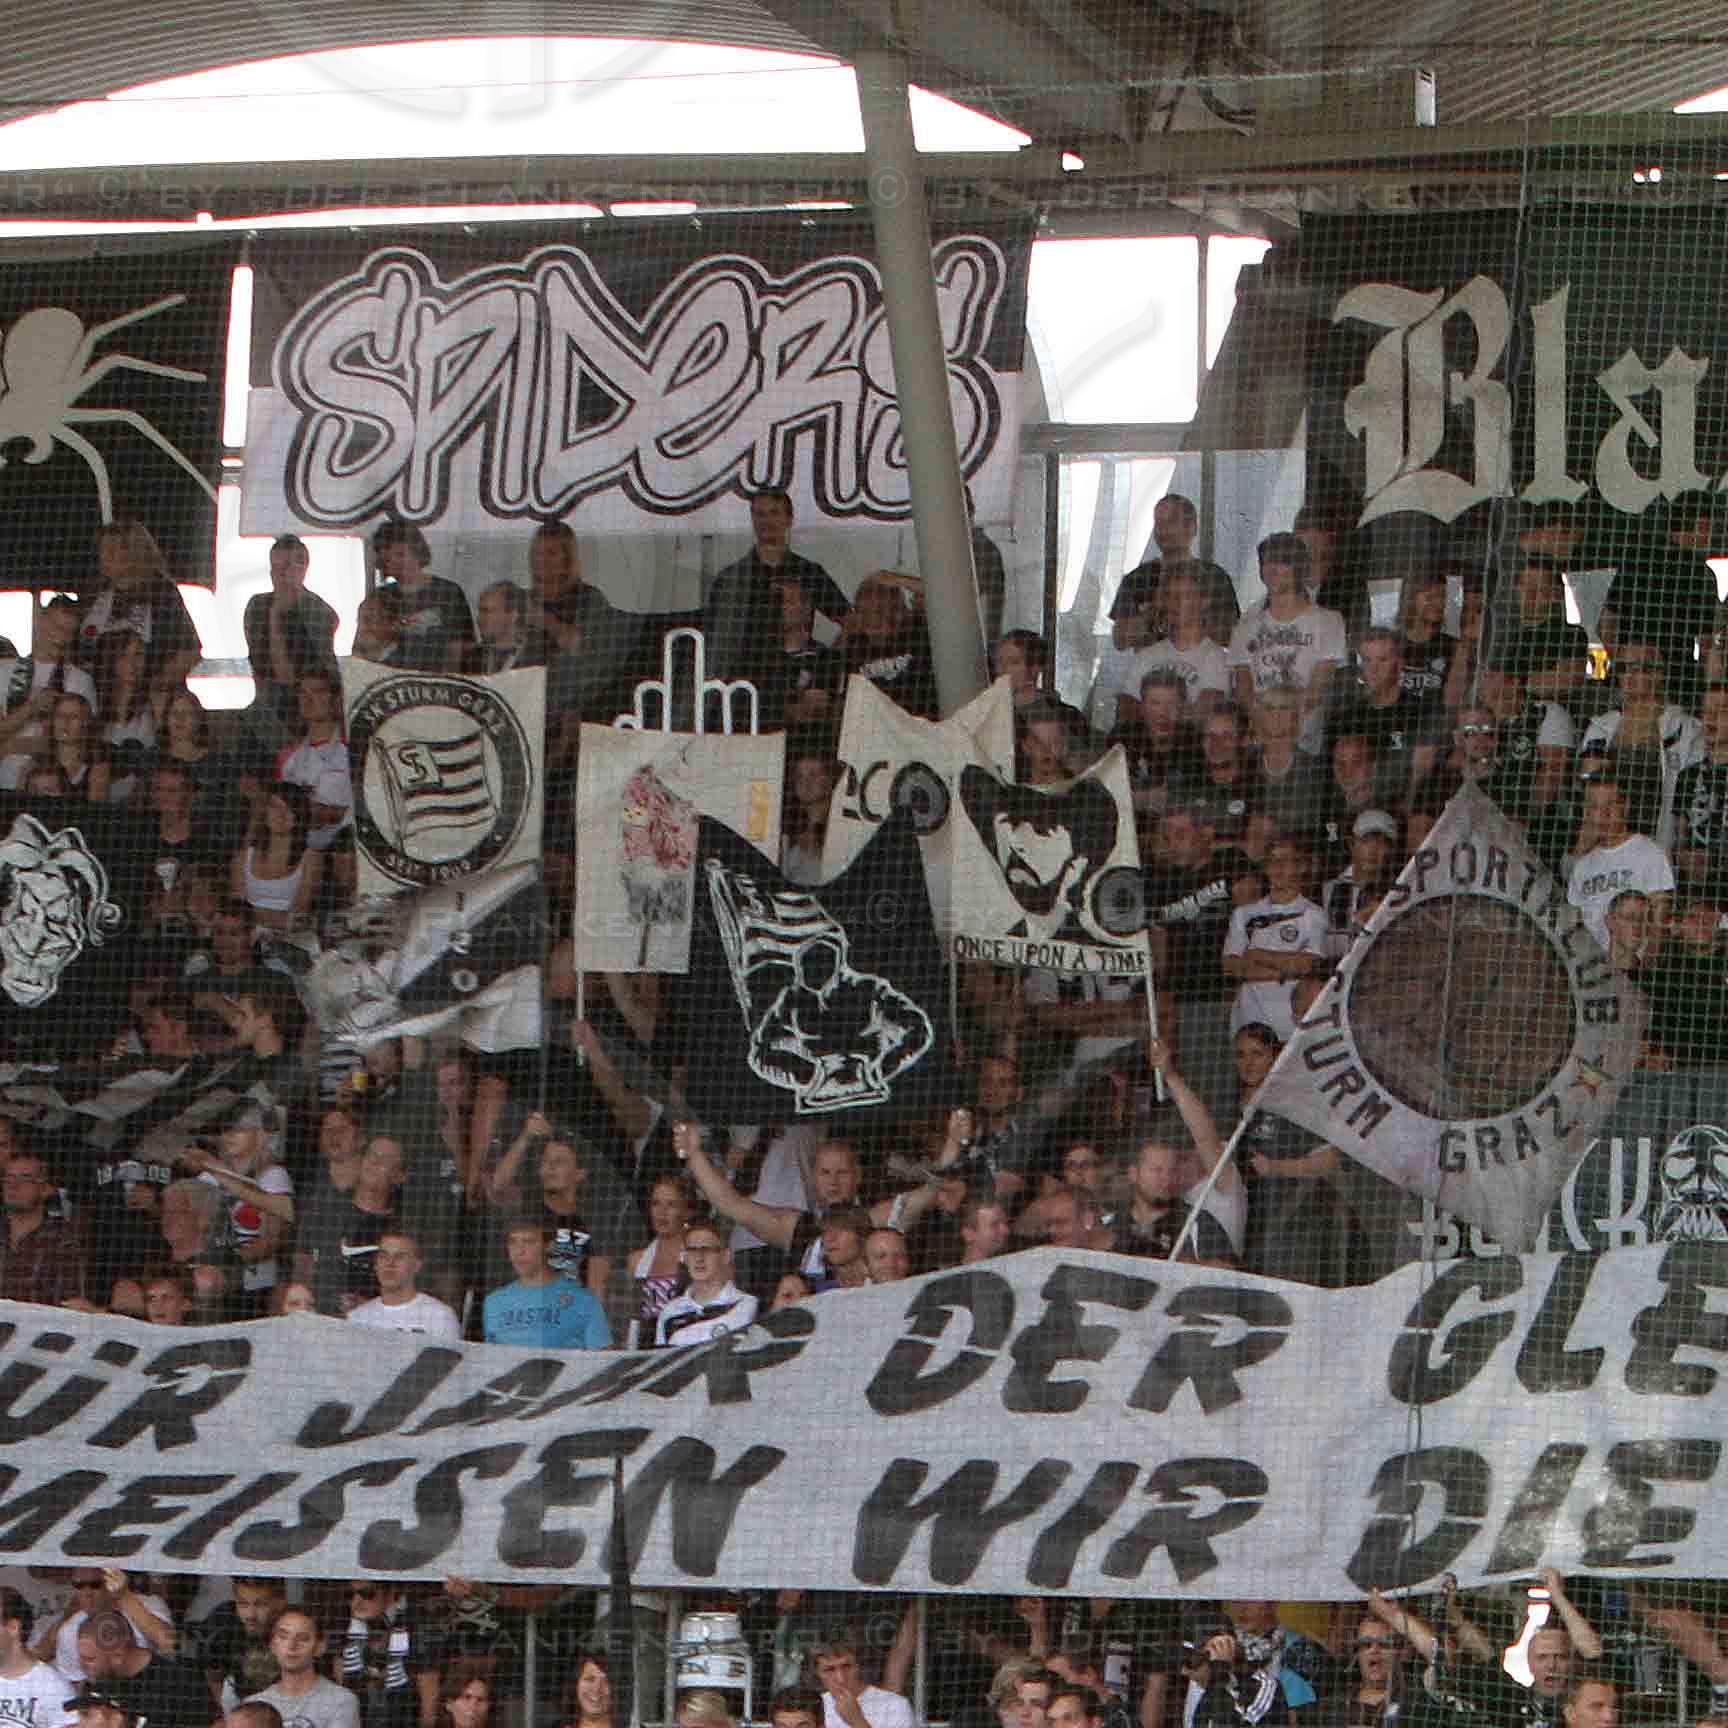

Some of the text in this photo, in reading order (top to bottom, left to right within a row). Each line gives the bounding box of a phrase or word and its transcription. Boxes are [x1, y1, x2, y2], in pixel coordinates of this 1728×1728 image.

[386, 685, 451, 712] STURM
[1580, 869, 1634, 897] GRAZ
[953, 935, 1148, 973] ONCE UPON A TIME
[1299, 966, 1579, 1174] STURM GRAZ
[298, 1306, 819, 1449] JAHR
[864, 1261, 1295, 1417] DER
[852, 1455, 1271, 1587] WIR
[1346, 1437, 1724, 1597] DIE
